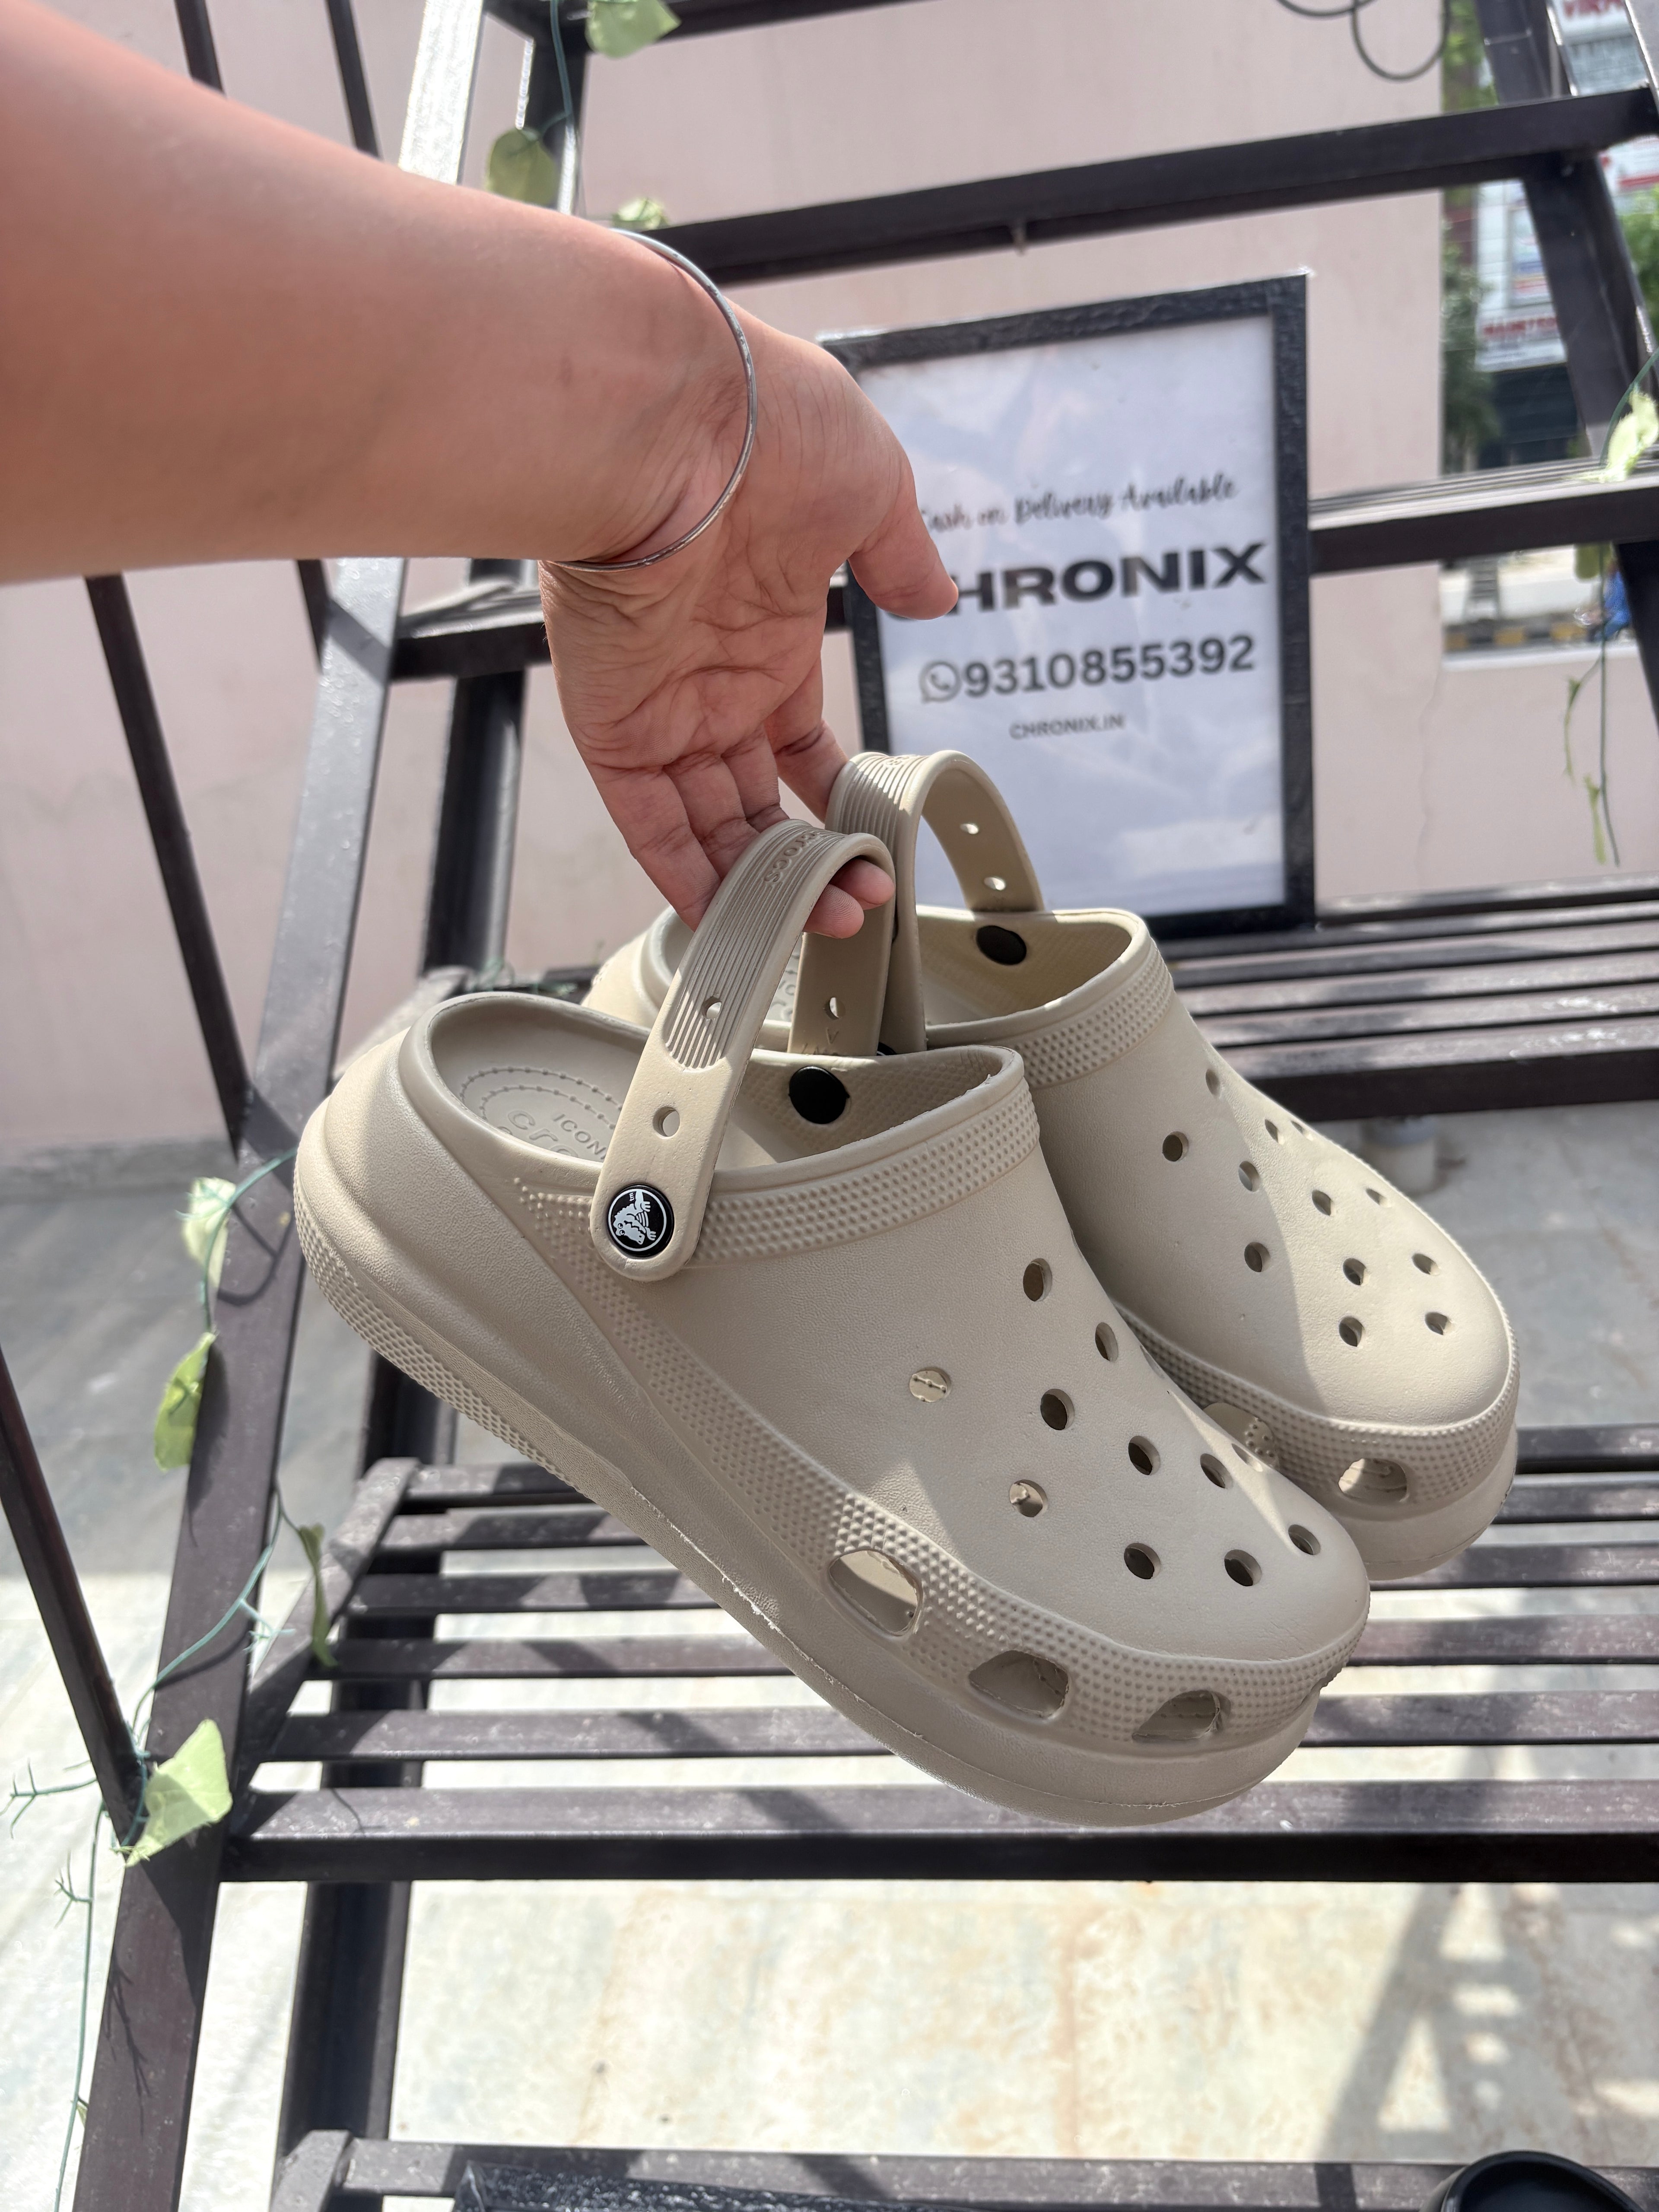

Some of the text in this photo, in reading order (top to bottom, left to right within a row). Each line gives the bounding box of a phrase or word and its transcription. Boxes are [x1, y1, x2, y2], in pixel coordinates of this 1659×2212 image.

[921, 503, 973, 532] ash
[1014, 492, 1113, 524] Delivery
[1121, 474, 1236, 511] Available
[889, 543, 1266, 620] HRONIX
[965, 636, 1255, 696] 9310855392
[1009, 714, 1126, 740] CHRONIX.IN
